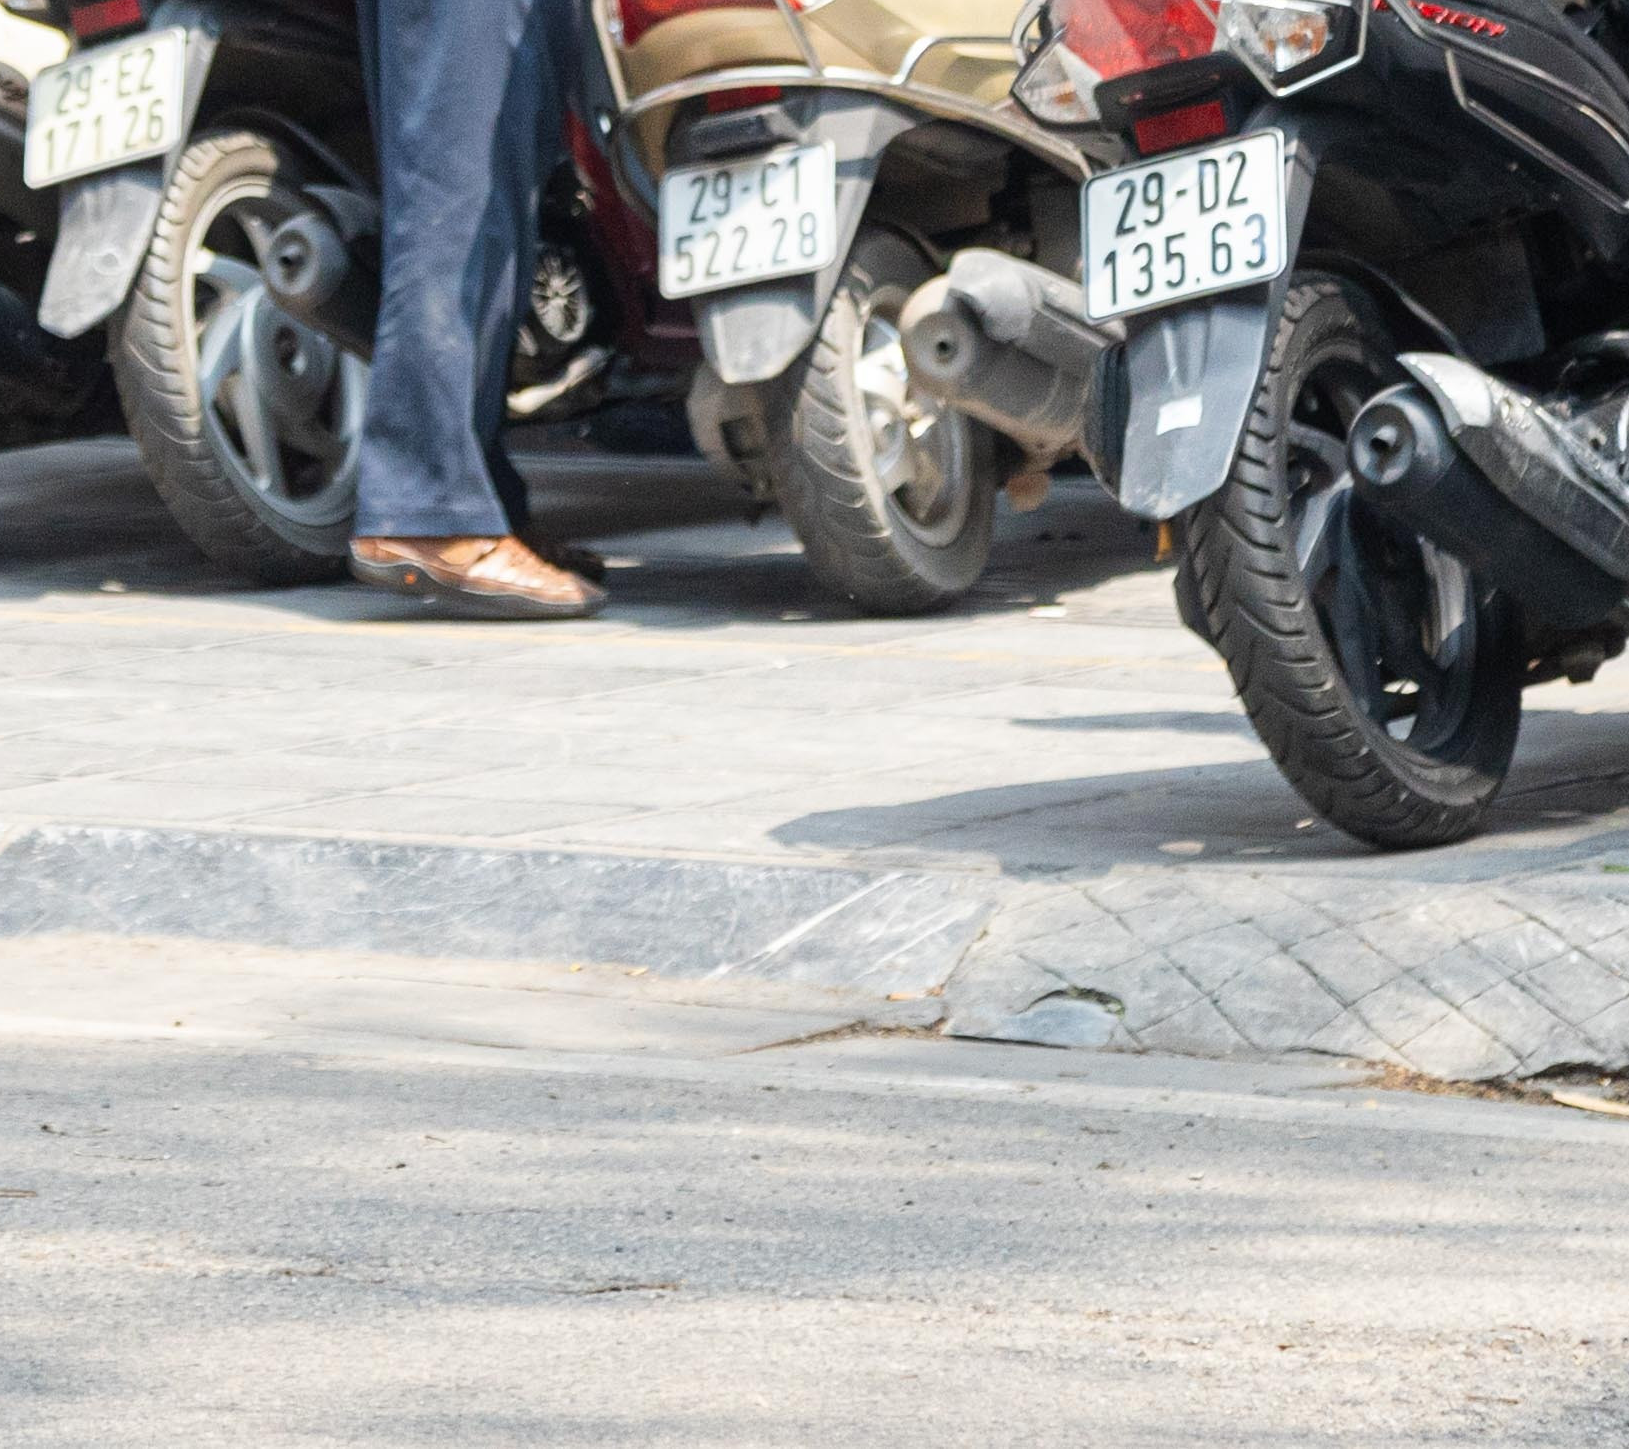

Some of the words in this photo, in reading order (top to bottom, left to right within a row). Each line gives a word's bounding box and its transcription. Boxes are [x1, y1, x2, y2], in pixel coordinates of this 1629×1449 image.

[54, 46, 156, 116] 29-E2
[44, 99, 165, 176] 171.26
[687, 156, 803, 226] 29-C1
[1113, 149, 1251, 238] 29-D2
[672, 207, 819, 286] 522.28
[1103, 211, 1268, 307] 135.63
